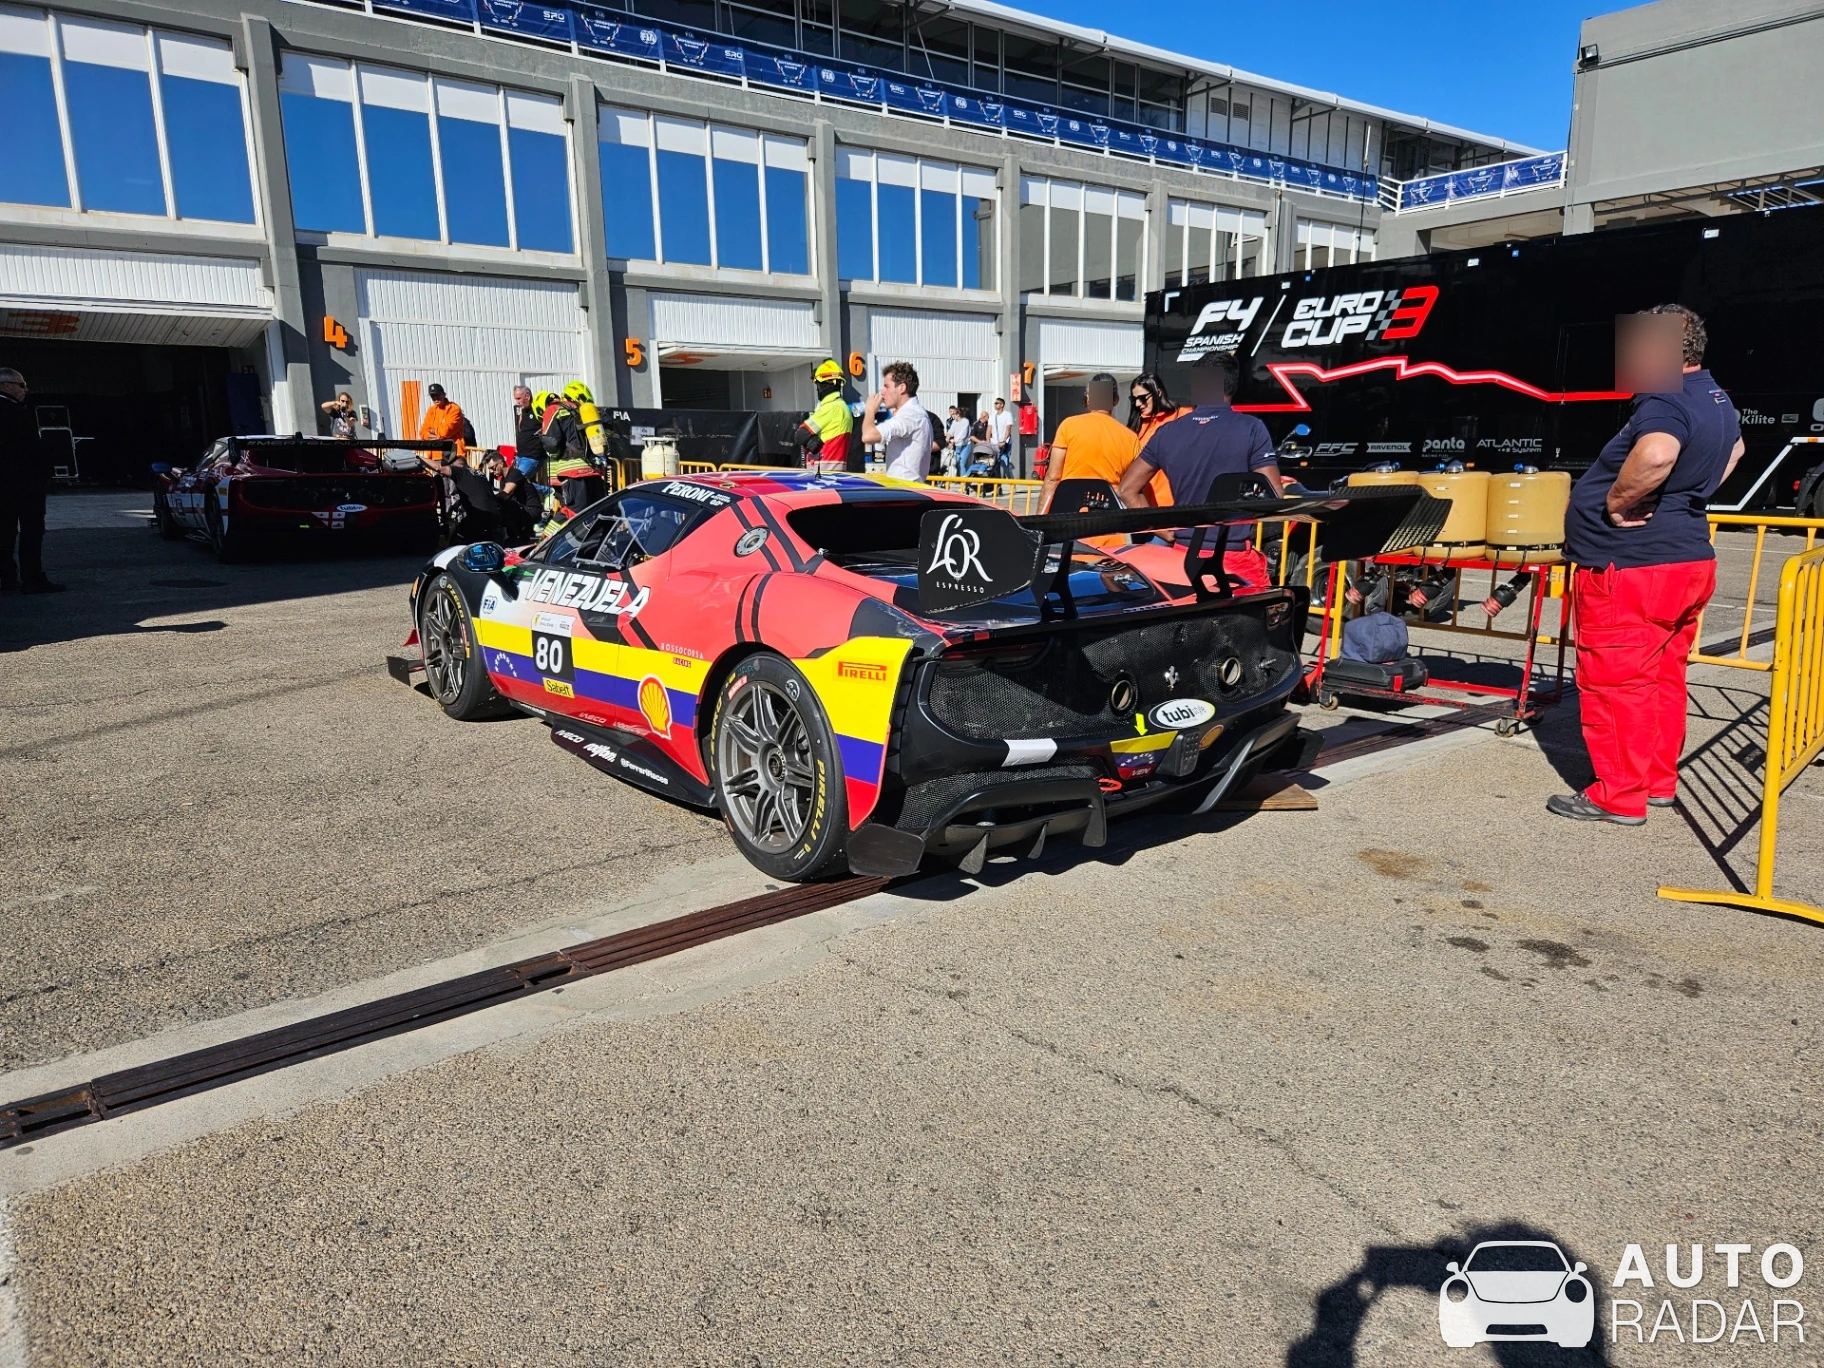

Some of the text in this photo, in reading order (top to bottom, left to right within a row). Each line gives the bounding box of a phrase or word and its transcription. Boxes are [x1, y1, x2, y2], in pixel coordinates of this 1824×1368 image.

[543, 10, 565, 20] SRO
[725, 49, 743, 59] SRO
[1293, 290, 1385, 320] EURO
[1381, 285, 1440, 340] 3
[1190, 296, 1264, 336] F4
[323, 315, 348, 349] 4
[1184, 332, 1245, 348] SPANISH
[1281, 314, 1372, 349] CUP
[625, 338, 642, 366] 5
[1181, 343, 1240, 355] CHAMPIONSHIP
[849, 351, 864, 376] 6
[1023, 362, 1035, 384] 7
[613, 410, 631, 422] FIA
[1741, 414, 1776, 425] Kilite
[1315, 442, 1359, 452] PFC
[1422, 436, 1466, 453] panta
[1476, 438, 1543, 448] ATLANTIC
[661, 481, 716, 503] PERONI
[525, 568, 651, 619] VENEZUELA
[936, 581, 985, 594] ESPRESSO
[483, 600, 496, 610] FIA
[535, 636, 563, 674] 80
[660, 642, 704, 660] ROSSOCORSA
[838, 661, 888, 682] PIRELLI
[546, 679, 572, 697] Sabelt
[1162, 705, 1195, 723] tubi
[555, 729, 585, 743] IVECO
[1131, 766, 1152, 776] VEN
[811, 759, 826, 841] PIRELLI
